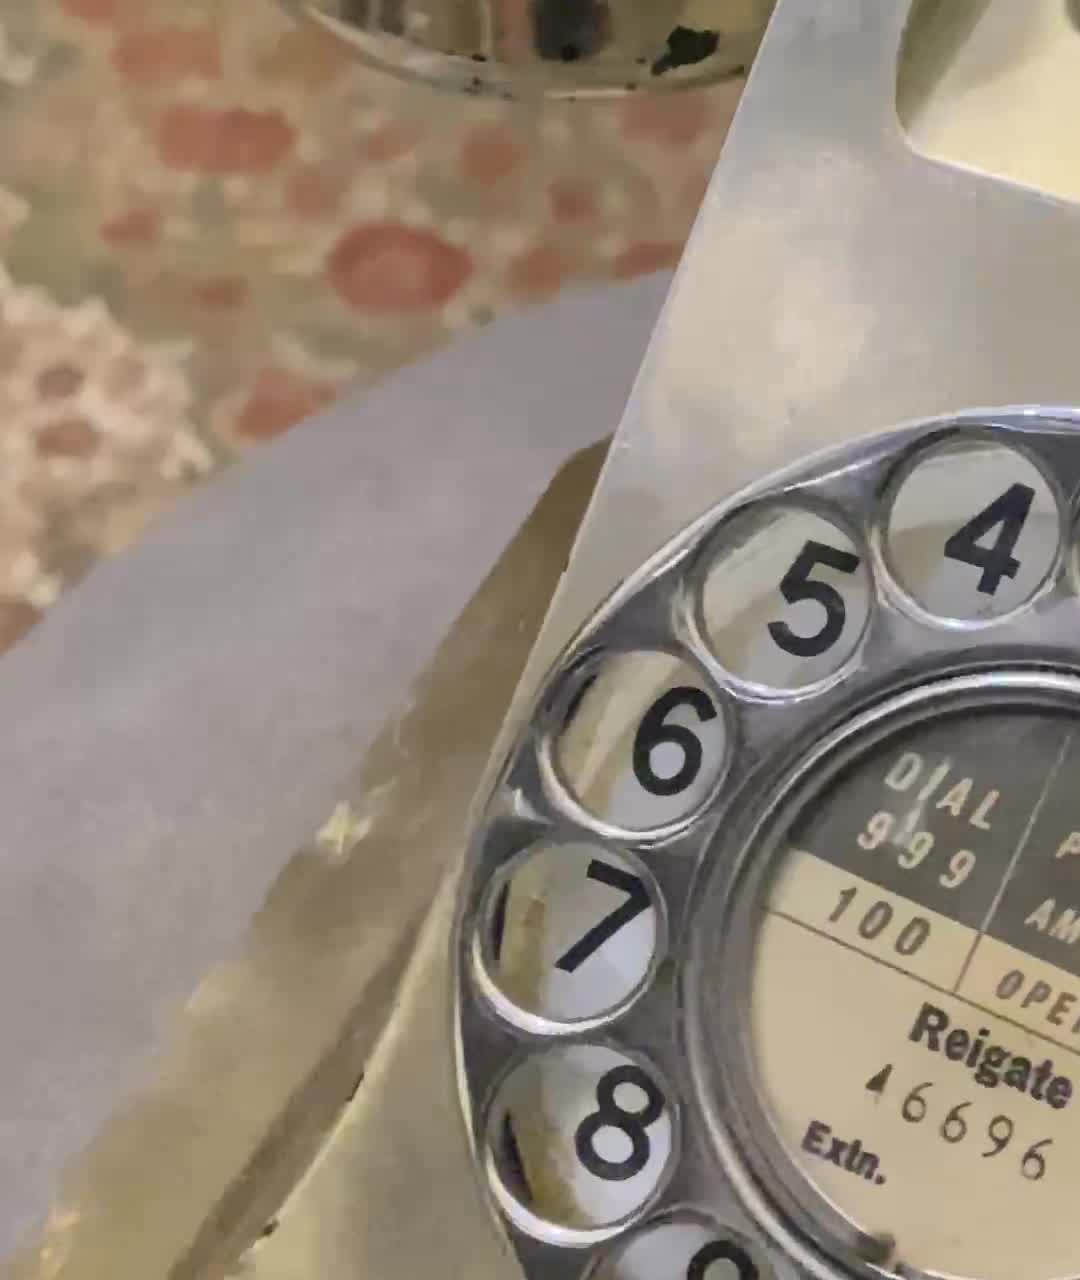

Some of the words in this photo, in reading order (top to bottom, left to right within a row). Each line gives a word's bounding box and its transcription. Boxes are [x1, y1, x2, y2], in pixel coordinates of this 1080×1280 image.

[943, 481, 1037, 596] 4
[767, 540, 861, 657] 5
[631, 686, 717, 798] 6
[882, 752, 1001, 831] DIAL
[855, 811, 977, 889] 999
[555, 859, 653, 976] 7
[823, 885, 932, 957] 100
[907, 1000, 1075, 1111] Reigate
[573, 1062, 664, 1182] 8
[800, 1120, 888, 1186] Extn.
